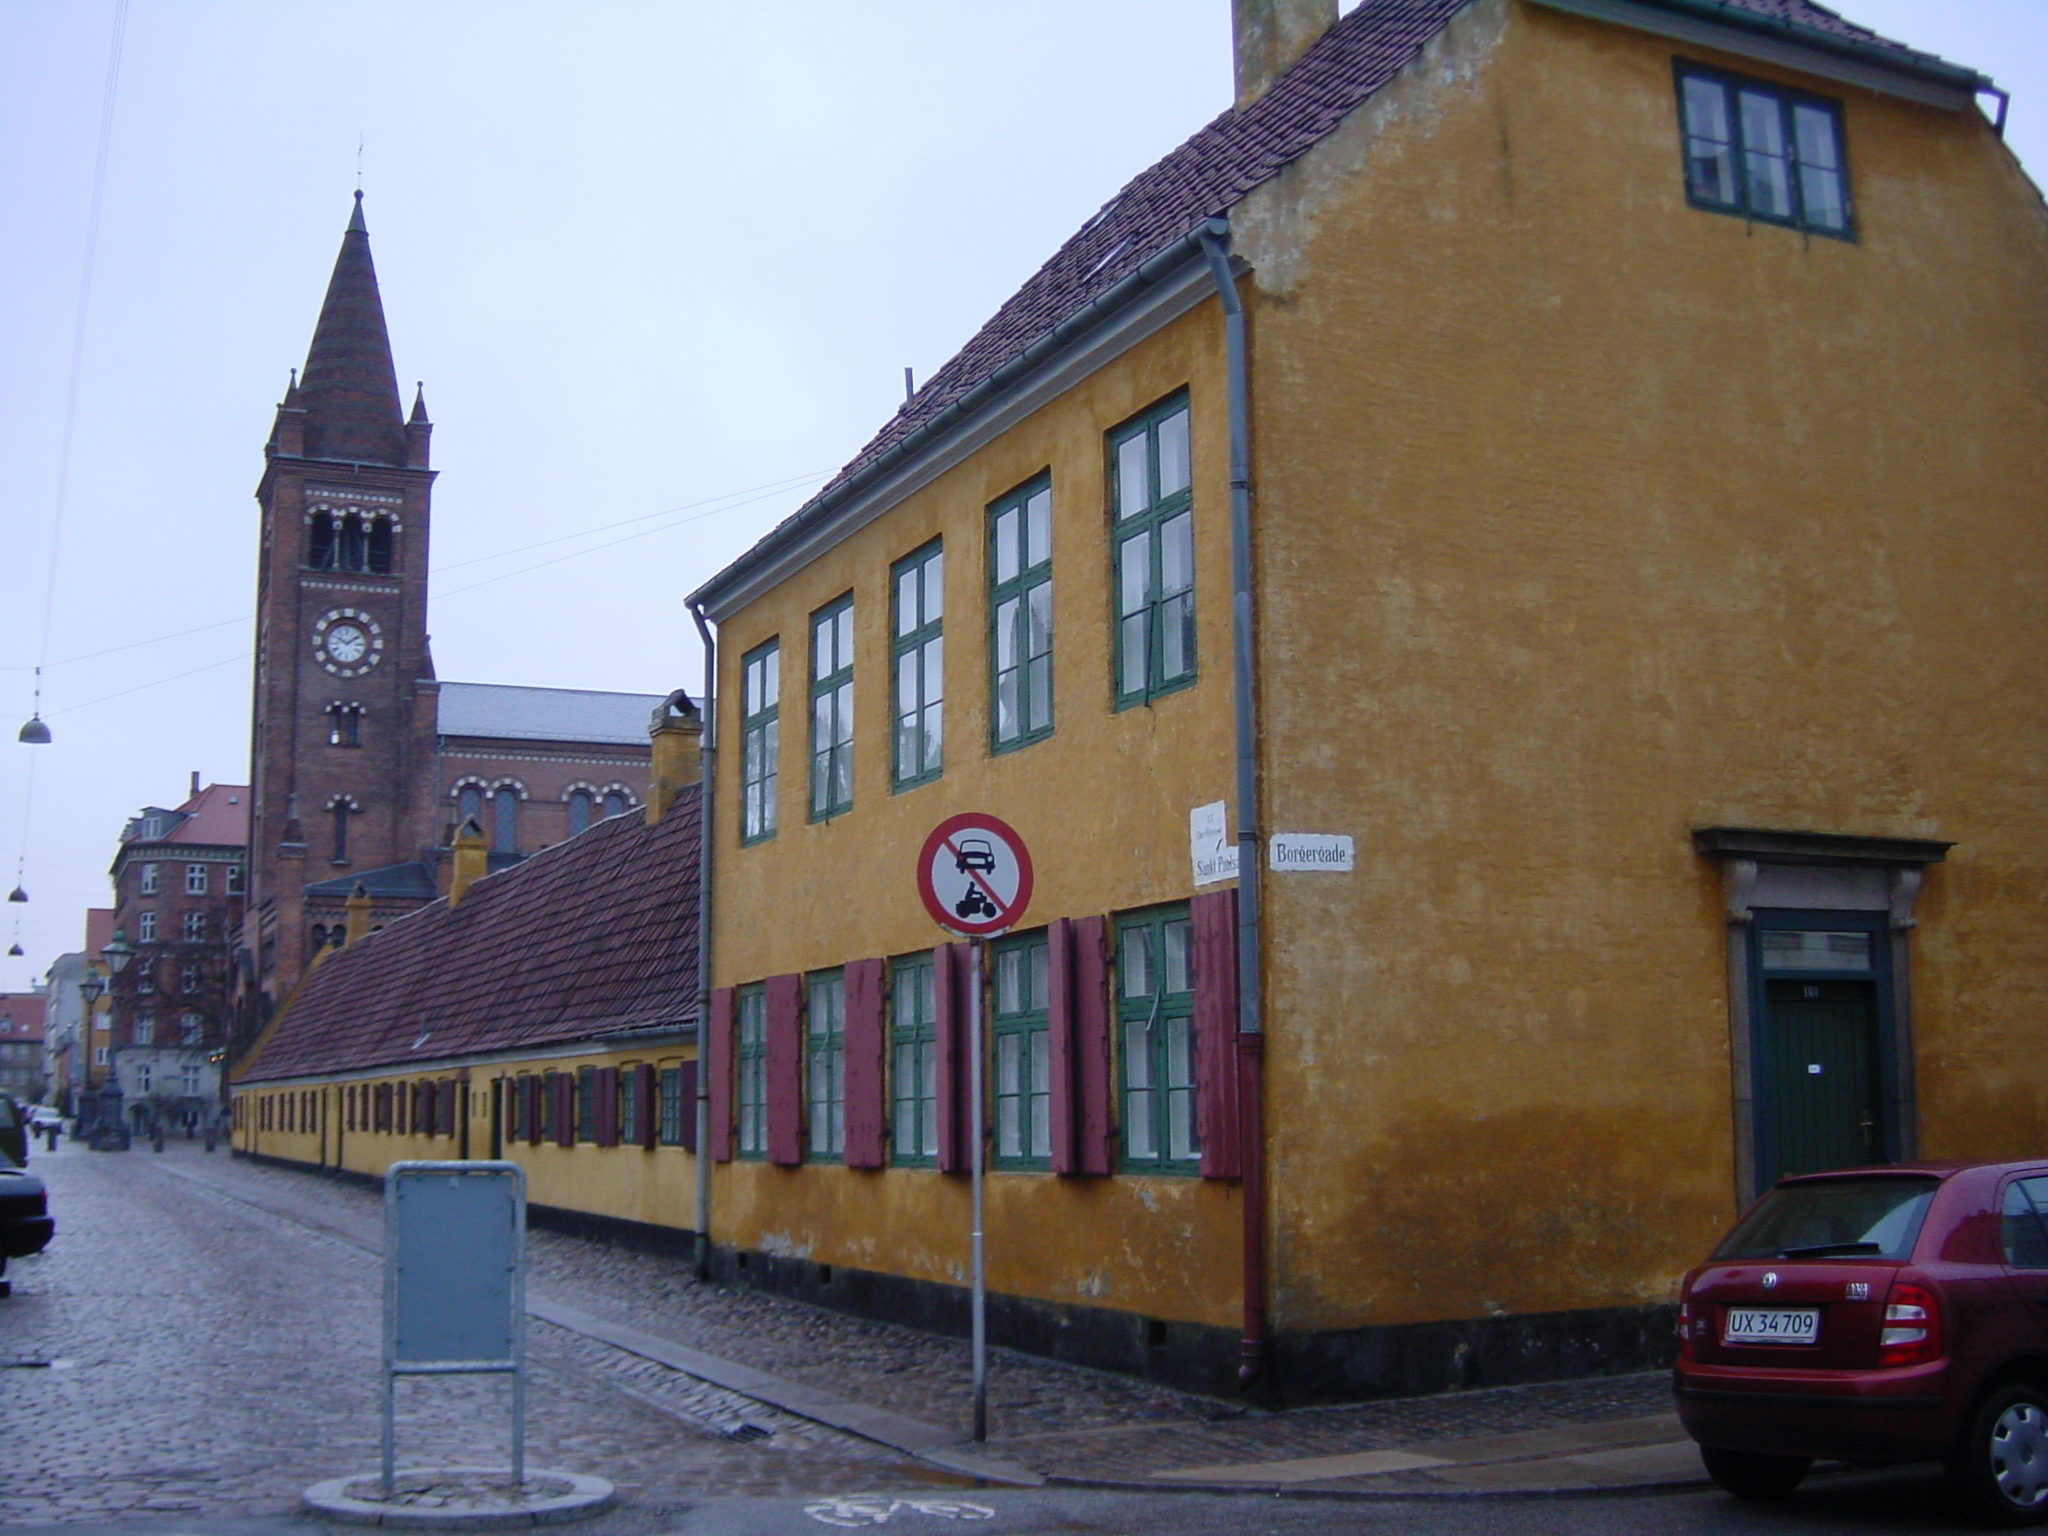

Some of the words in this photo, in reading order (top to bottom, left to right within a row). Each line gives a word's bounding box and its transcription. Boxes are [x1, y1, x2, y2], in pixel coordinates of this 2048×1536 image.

[1276, 843, 1346, 863] Borgergade
[1731, 1313, 1754, 1333] UX
[1758, 1313, 1778, 1333] 34
[1783, 1314, 1813, 1334] 709
